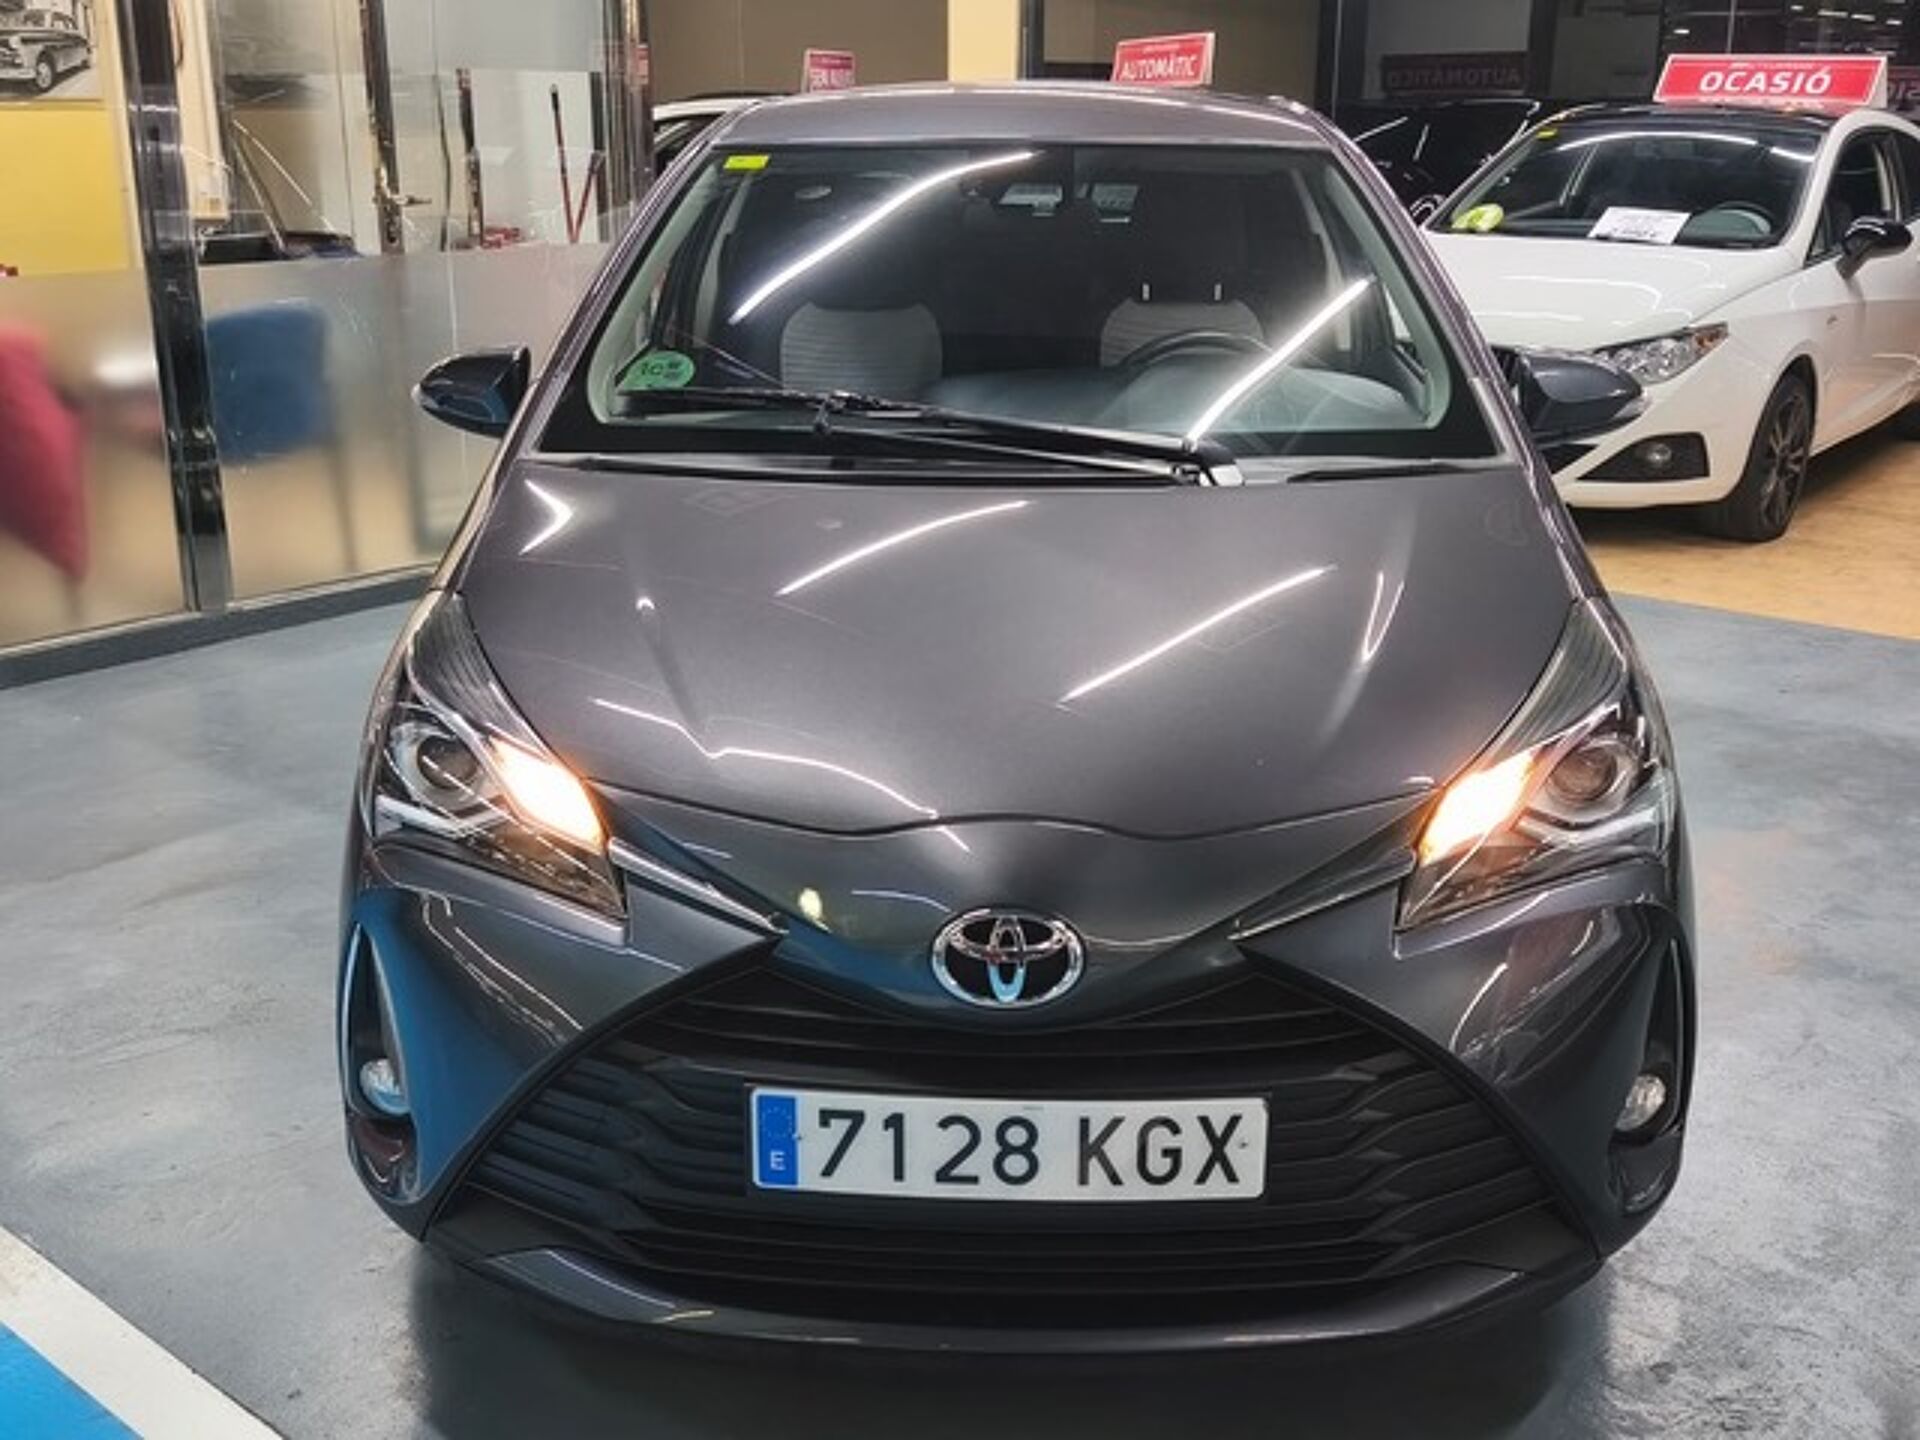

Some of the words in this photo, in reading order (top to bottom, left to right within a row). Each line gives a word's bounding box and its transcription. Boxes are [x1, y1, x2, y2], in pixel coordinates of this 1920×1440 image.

[1699, 66, 1832, 94] OCASIÓ
[770, 1151, 785, 1171] E
[818, 1109, 1039, 1186] 7128
[1077, 1114, 1243, 1186] KGX
